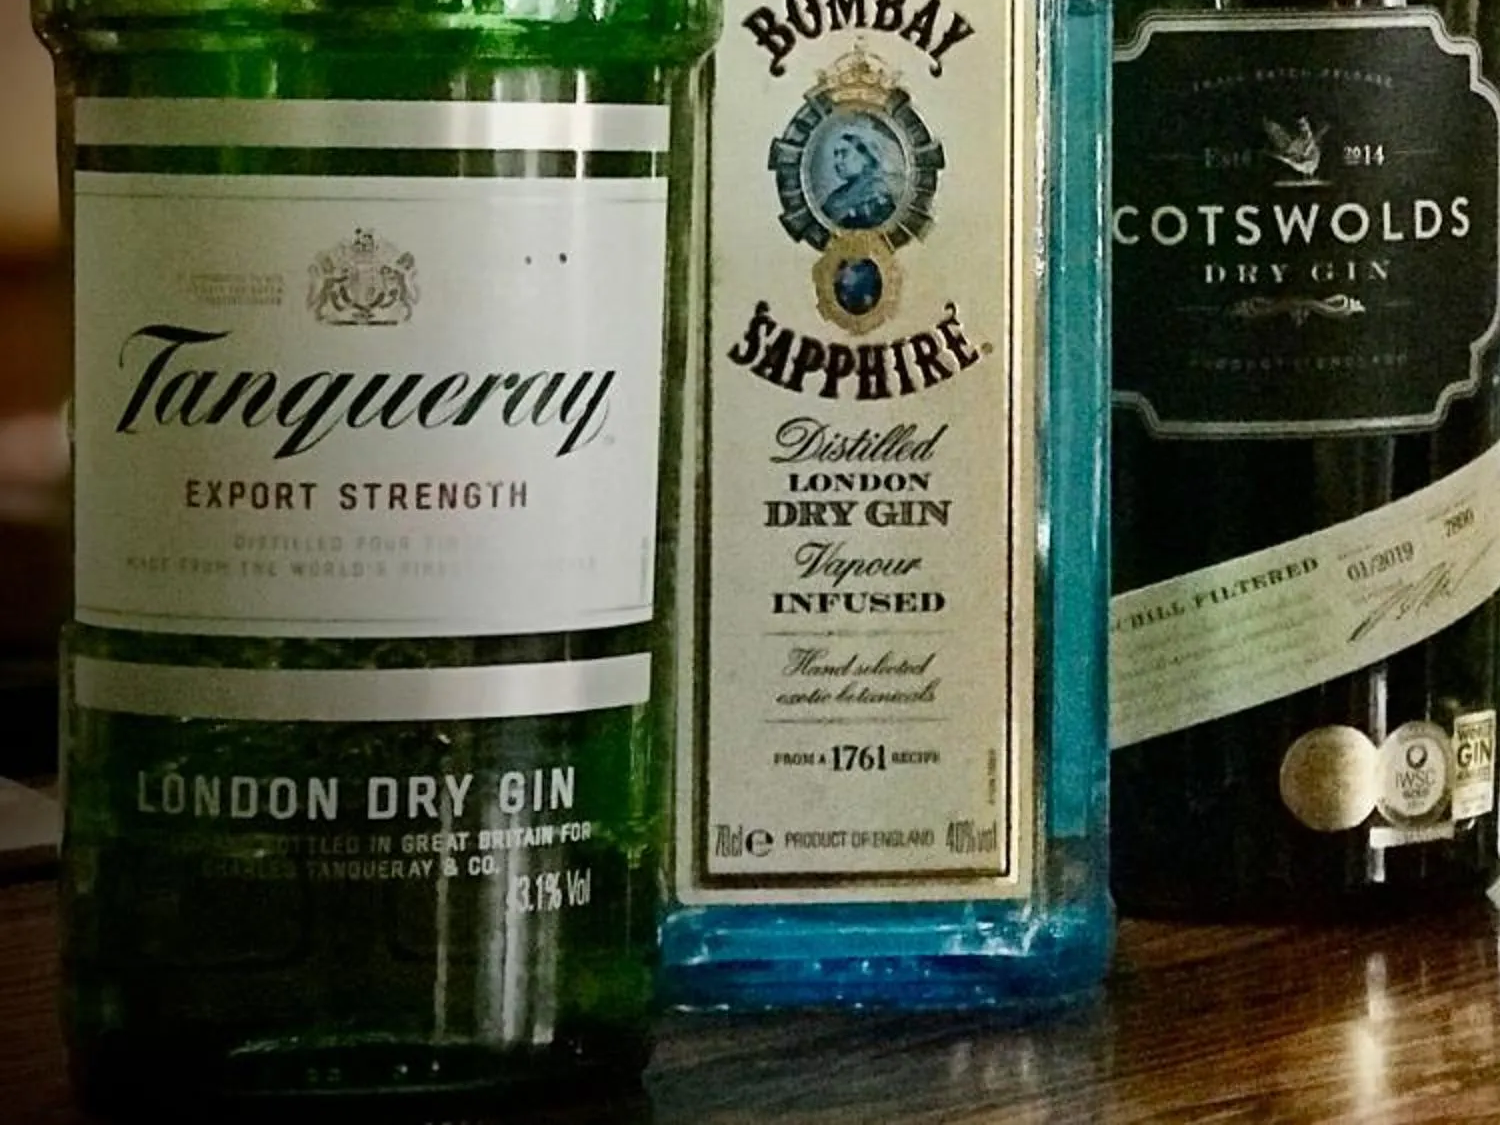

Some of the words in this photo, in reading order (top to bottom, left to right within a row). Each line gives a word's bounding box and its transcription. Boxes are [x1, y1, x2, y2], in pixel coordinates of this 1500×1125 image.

[1343, 143, 1386, 167] 2014
[1112, 195, 1472, 248] COTSWOLDS
[1204, 263, 1290, 285] DRY
[1310, 258, 1392, 282] GIN
[727, 300, 982, 401] SAPPHIRE
[116, 324, 617, 460] Tanqueray
[769, 415, 949, 465] Distilled
[186, 479, 318, 511] EXPORT
[339, 479, 528, 510] STRENGTH
[788, 472, 932, 493] LONDON
[763, 500, 857, 528] DRY
[865, 499, 953, 527] GIN
[795, 541, 923, 588] Vapour
[1191, 556, 1320, 609] FILTERED
[772, 591, 946, 615] INFUSED
[783, 647, 860, 677] Hand
[773, 751, 815, 766] FROM
[817, 754, 827, 765] A
[830, 743, 887, 772] 1761
[890, 751, 941, 765] RECIPE
[1457, 739, 1493, 768] GIN
[137, 770, 339, 821] LONDON
[367, 774, 475, 821] DRY
[500, 766, 576, 815] GIN
[369, 833, 391, 854] IN
[400, 831, 470, 854] GREAT
[478, 824, 554, 852] BRITAIN
[559, 820, 593, 844] FOR
[784, 830, 847, 849] PRODUCT
[850, 831, 869, 848] OF
[871, 828, 936, 848] ENGLAND
[306, 857, 433, 881] TANQUERAY
[442, 856, 459, 876] &
[467, 854, 501, 876] CO.
[566, 867, 592, 908] Vol
